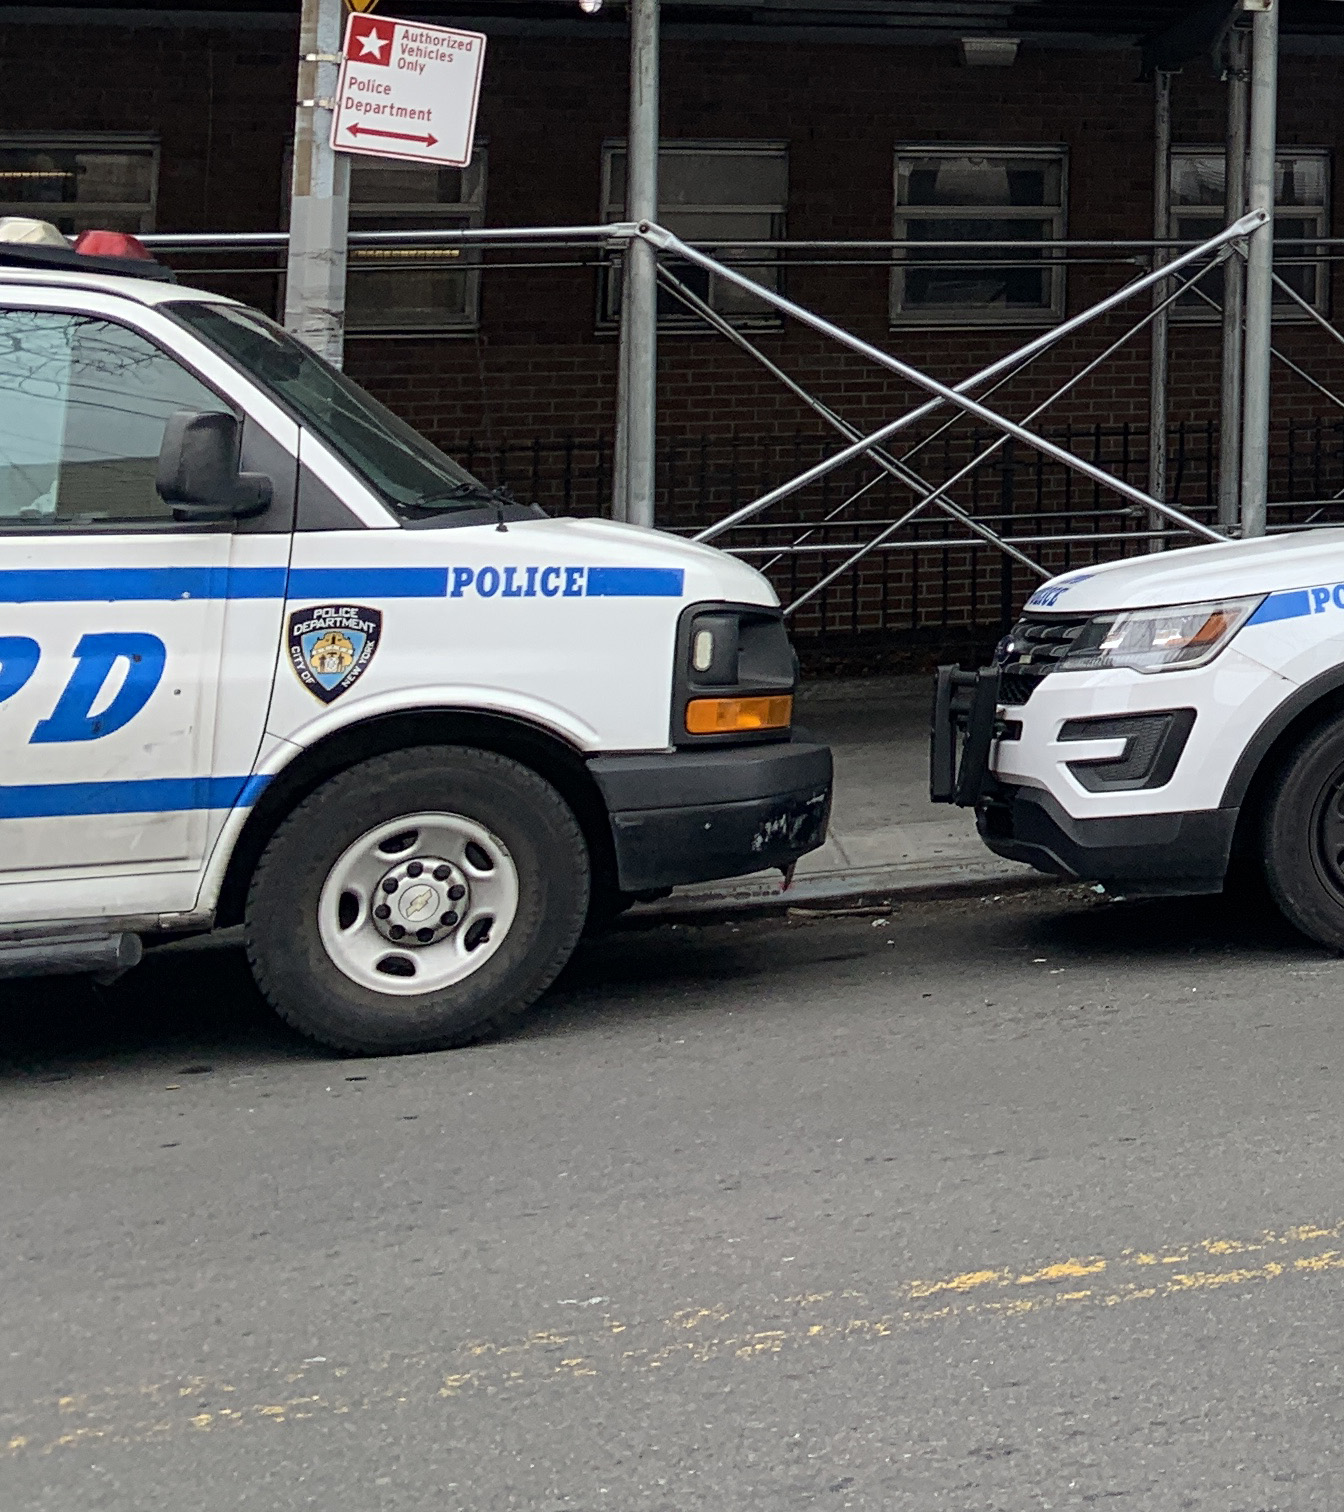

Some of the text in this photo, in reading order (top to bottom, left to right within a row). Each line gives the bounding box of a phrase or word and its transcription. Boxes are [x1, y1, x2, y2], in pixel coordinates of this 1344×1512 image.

[401, 29, 473, 52] Authorized
[400, 43, 454, 63] Vehicles
[397, 57, 426, 75] Only
[347, 76, 392, 95] Police
[345, 96, 433, 122] Department
[450, 566, 585, 597] POLICE
[313, 607, 359, 619] POLICE
[293, 617, 377, 636] DEPARTMENT
[291, 645, 317, 685] CITY OF
[341, 640, 376, 688] NEW YORK
